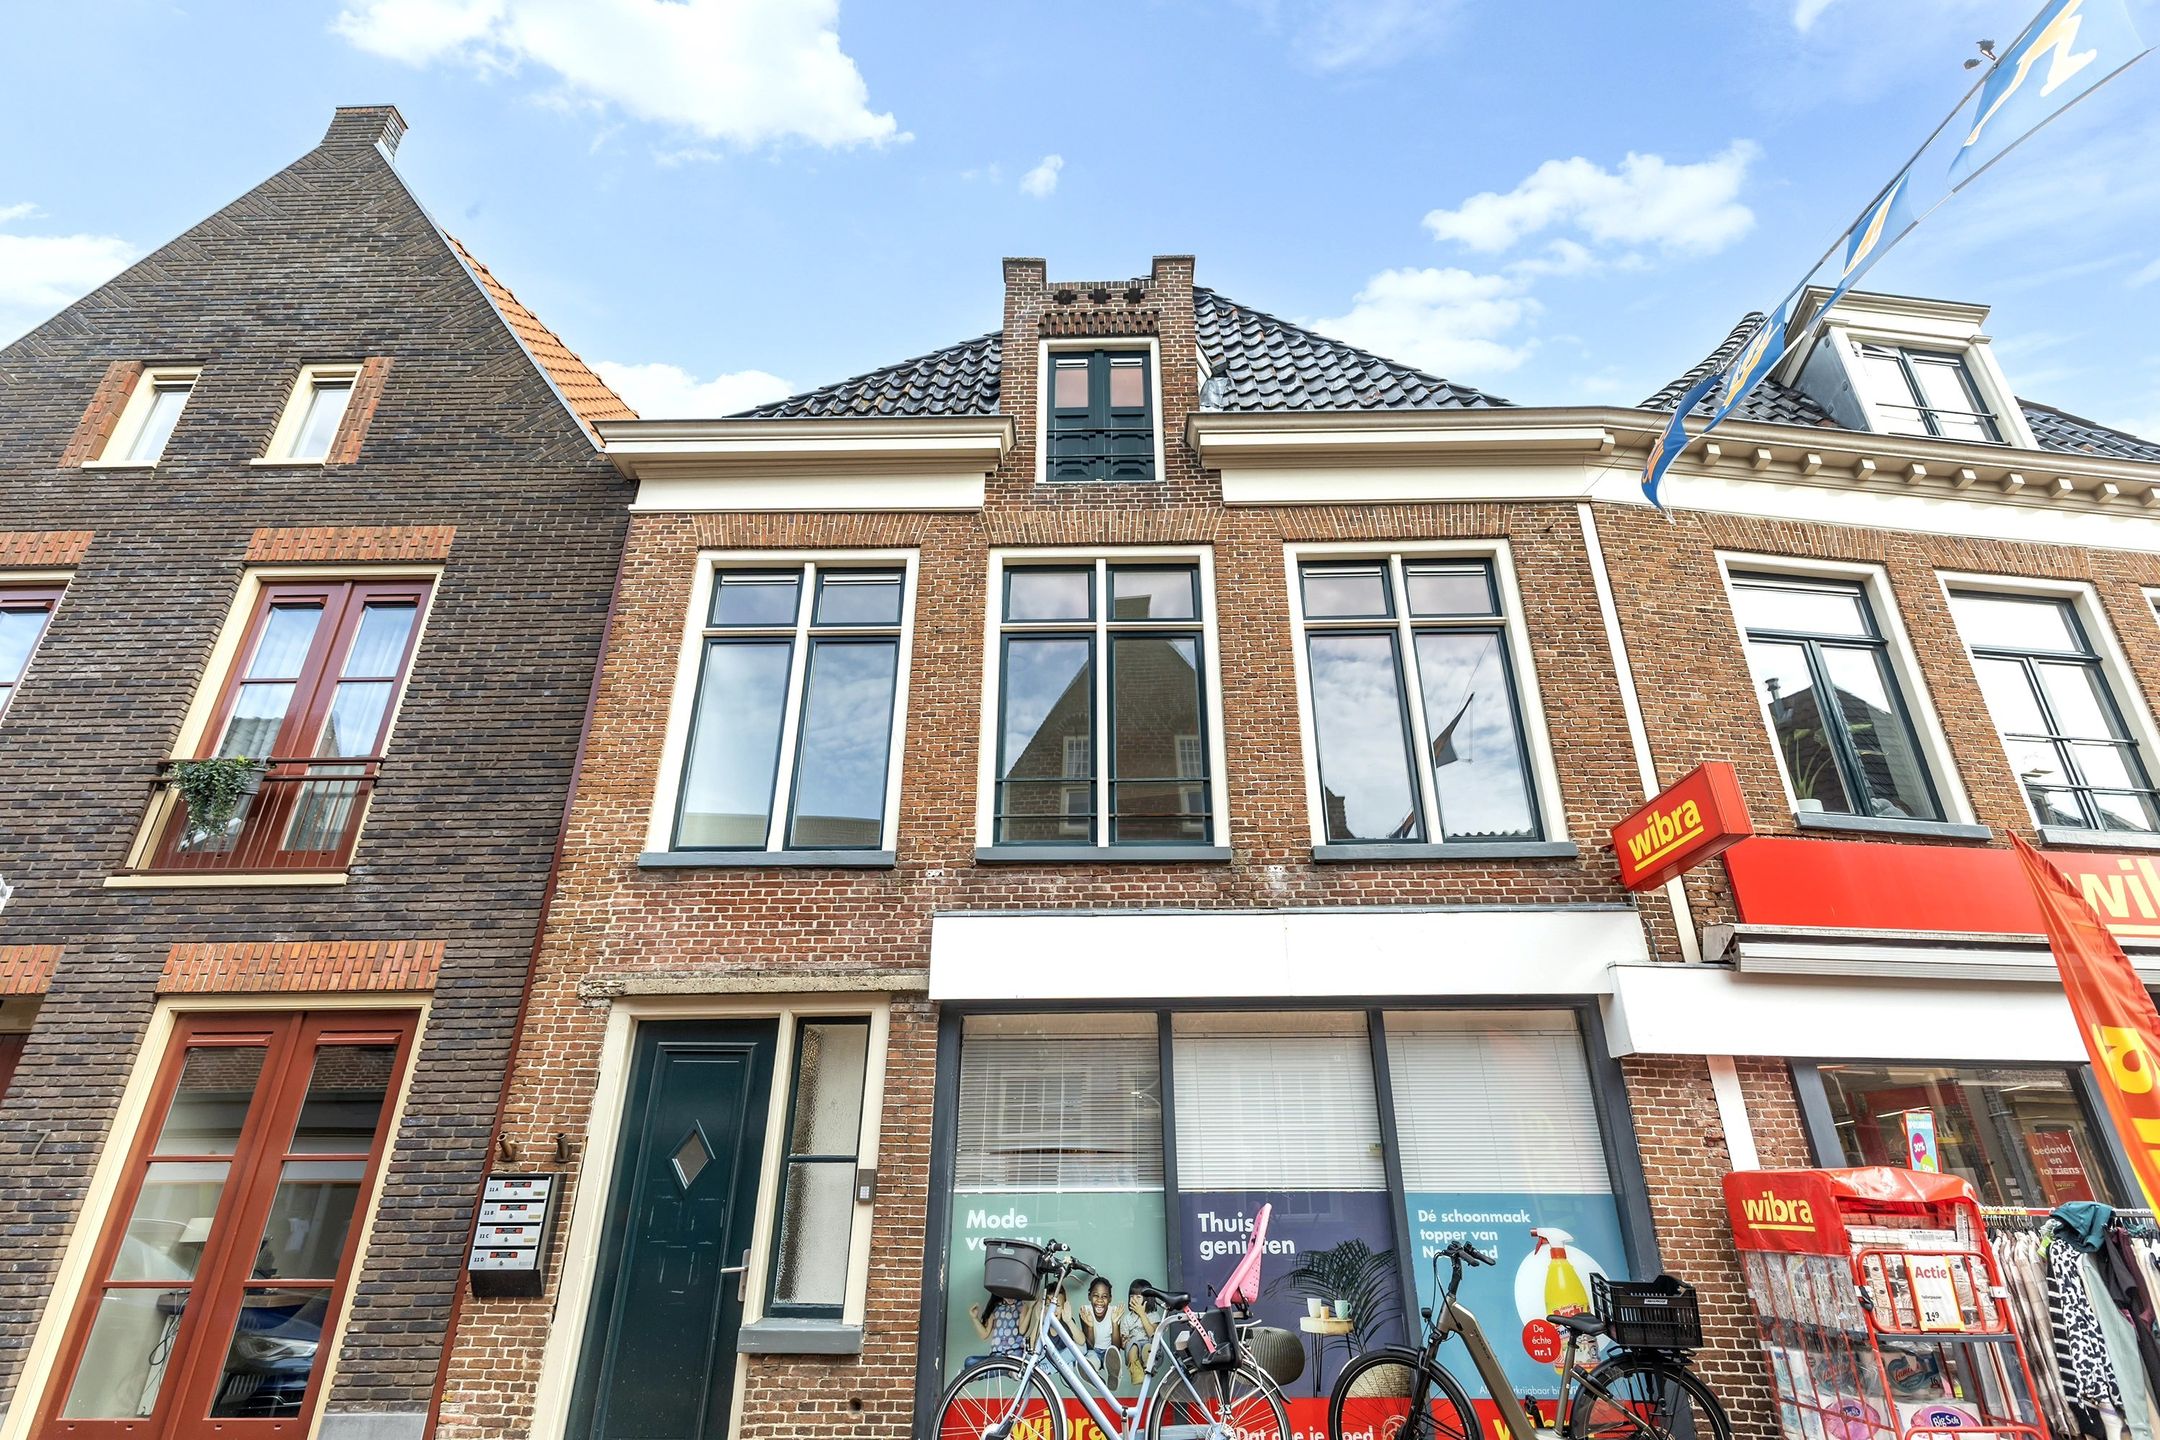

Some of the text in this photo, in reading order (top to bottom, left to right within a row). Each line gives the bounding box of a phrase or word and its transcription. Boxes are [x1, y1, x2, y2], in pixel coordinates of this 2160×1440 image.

[1628, 800, 1701, 861] wibra
[2032, 1144, 2073, 1155] bedankt
[2056, 1165, 2080, 1175] ziens
[1742, 1190, 1813, 1223] wibra
[966, 1207, 1028, 1229] Mode
[1197, 1211, 1254, 1233] Thuis
[1417, 1208, 1531, 1223] Dé schoonmaak
[1420, 1229, 1498, 1244] topper van
[1200, 1233, 1296, 1261] geniten
[1915, 1265, 1947, 1279] Actie
[1533, 1324, 1545, 1333] De
